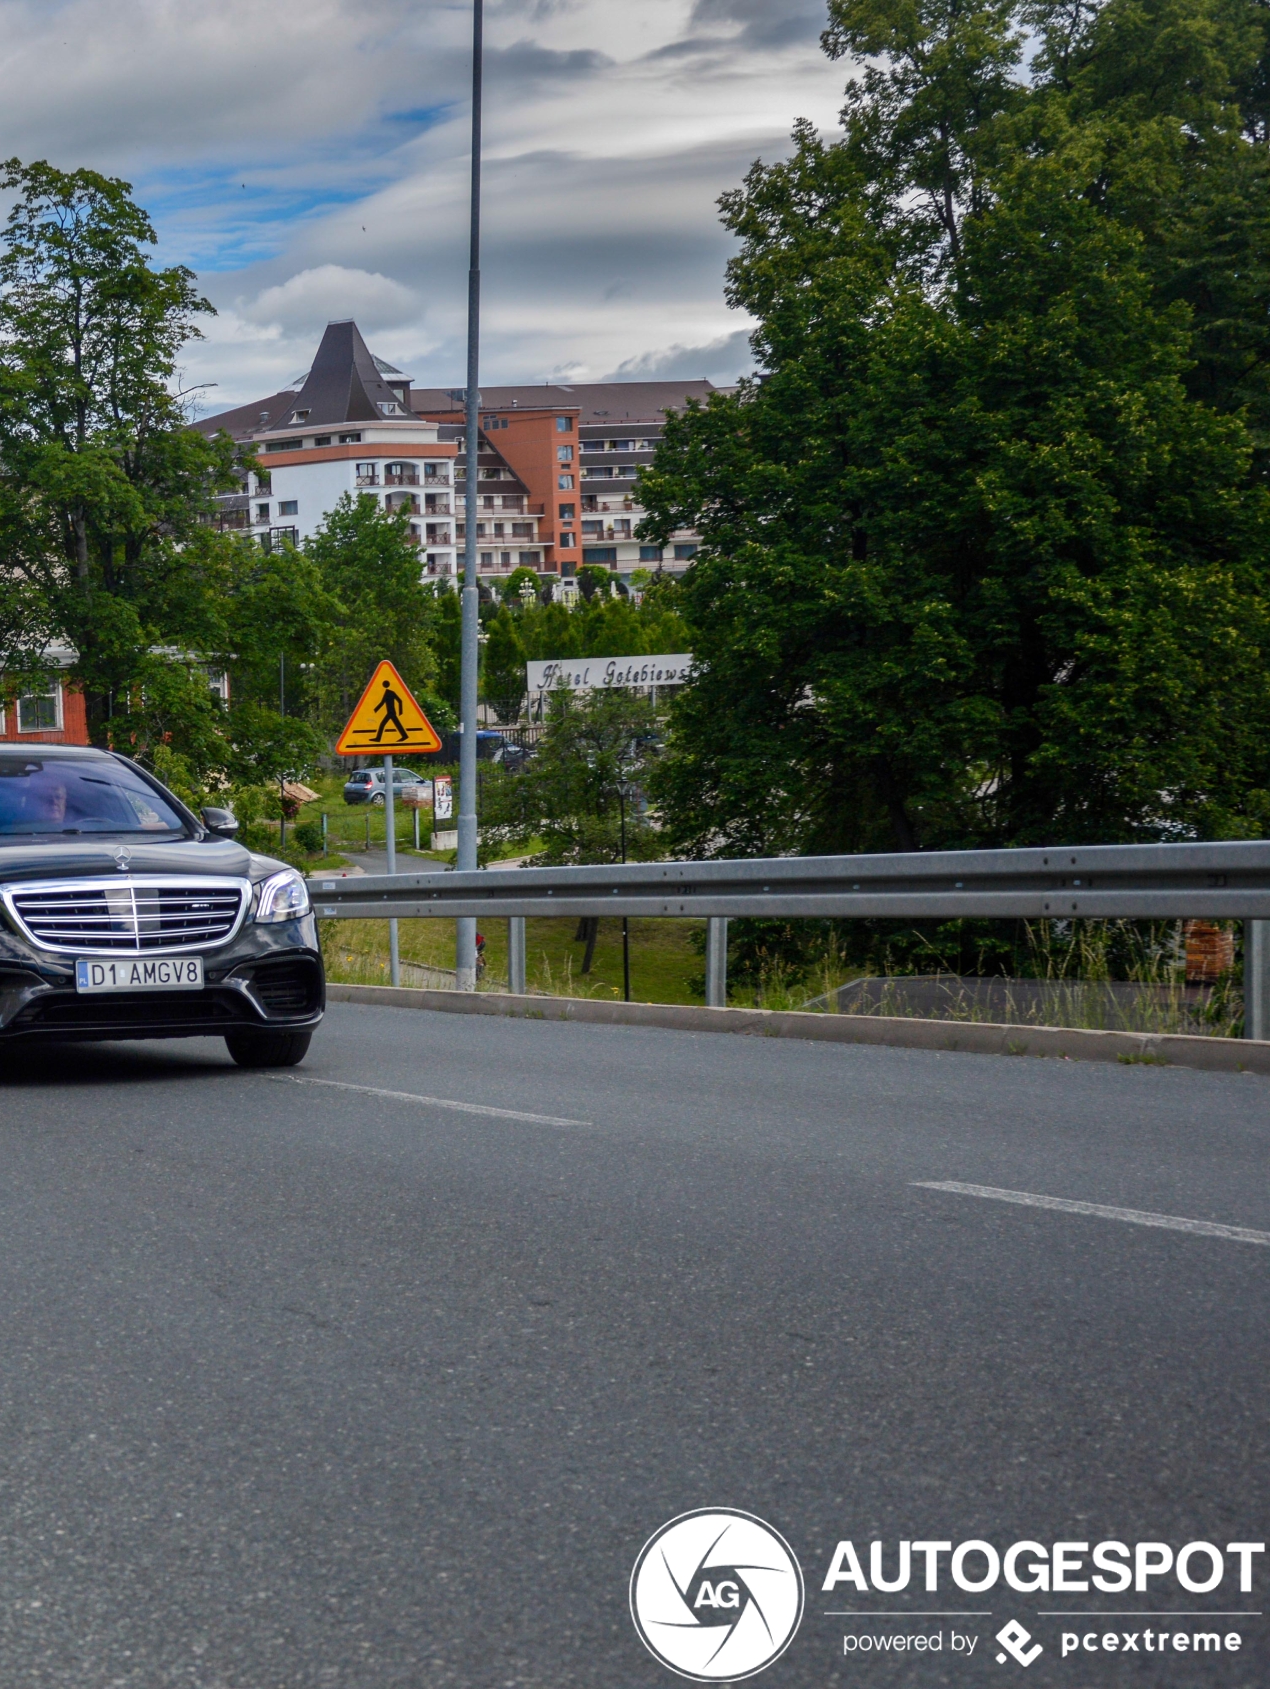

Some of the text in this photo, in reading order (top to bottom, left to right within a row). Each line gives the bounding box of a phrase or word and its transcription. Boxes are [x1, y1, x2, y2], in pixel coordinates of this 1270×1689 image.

[603, 660, 687, 685] Gołębiews
[92, 964, 116, 985] D1
[130, 962, 198, 984] AMGV8
